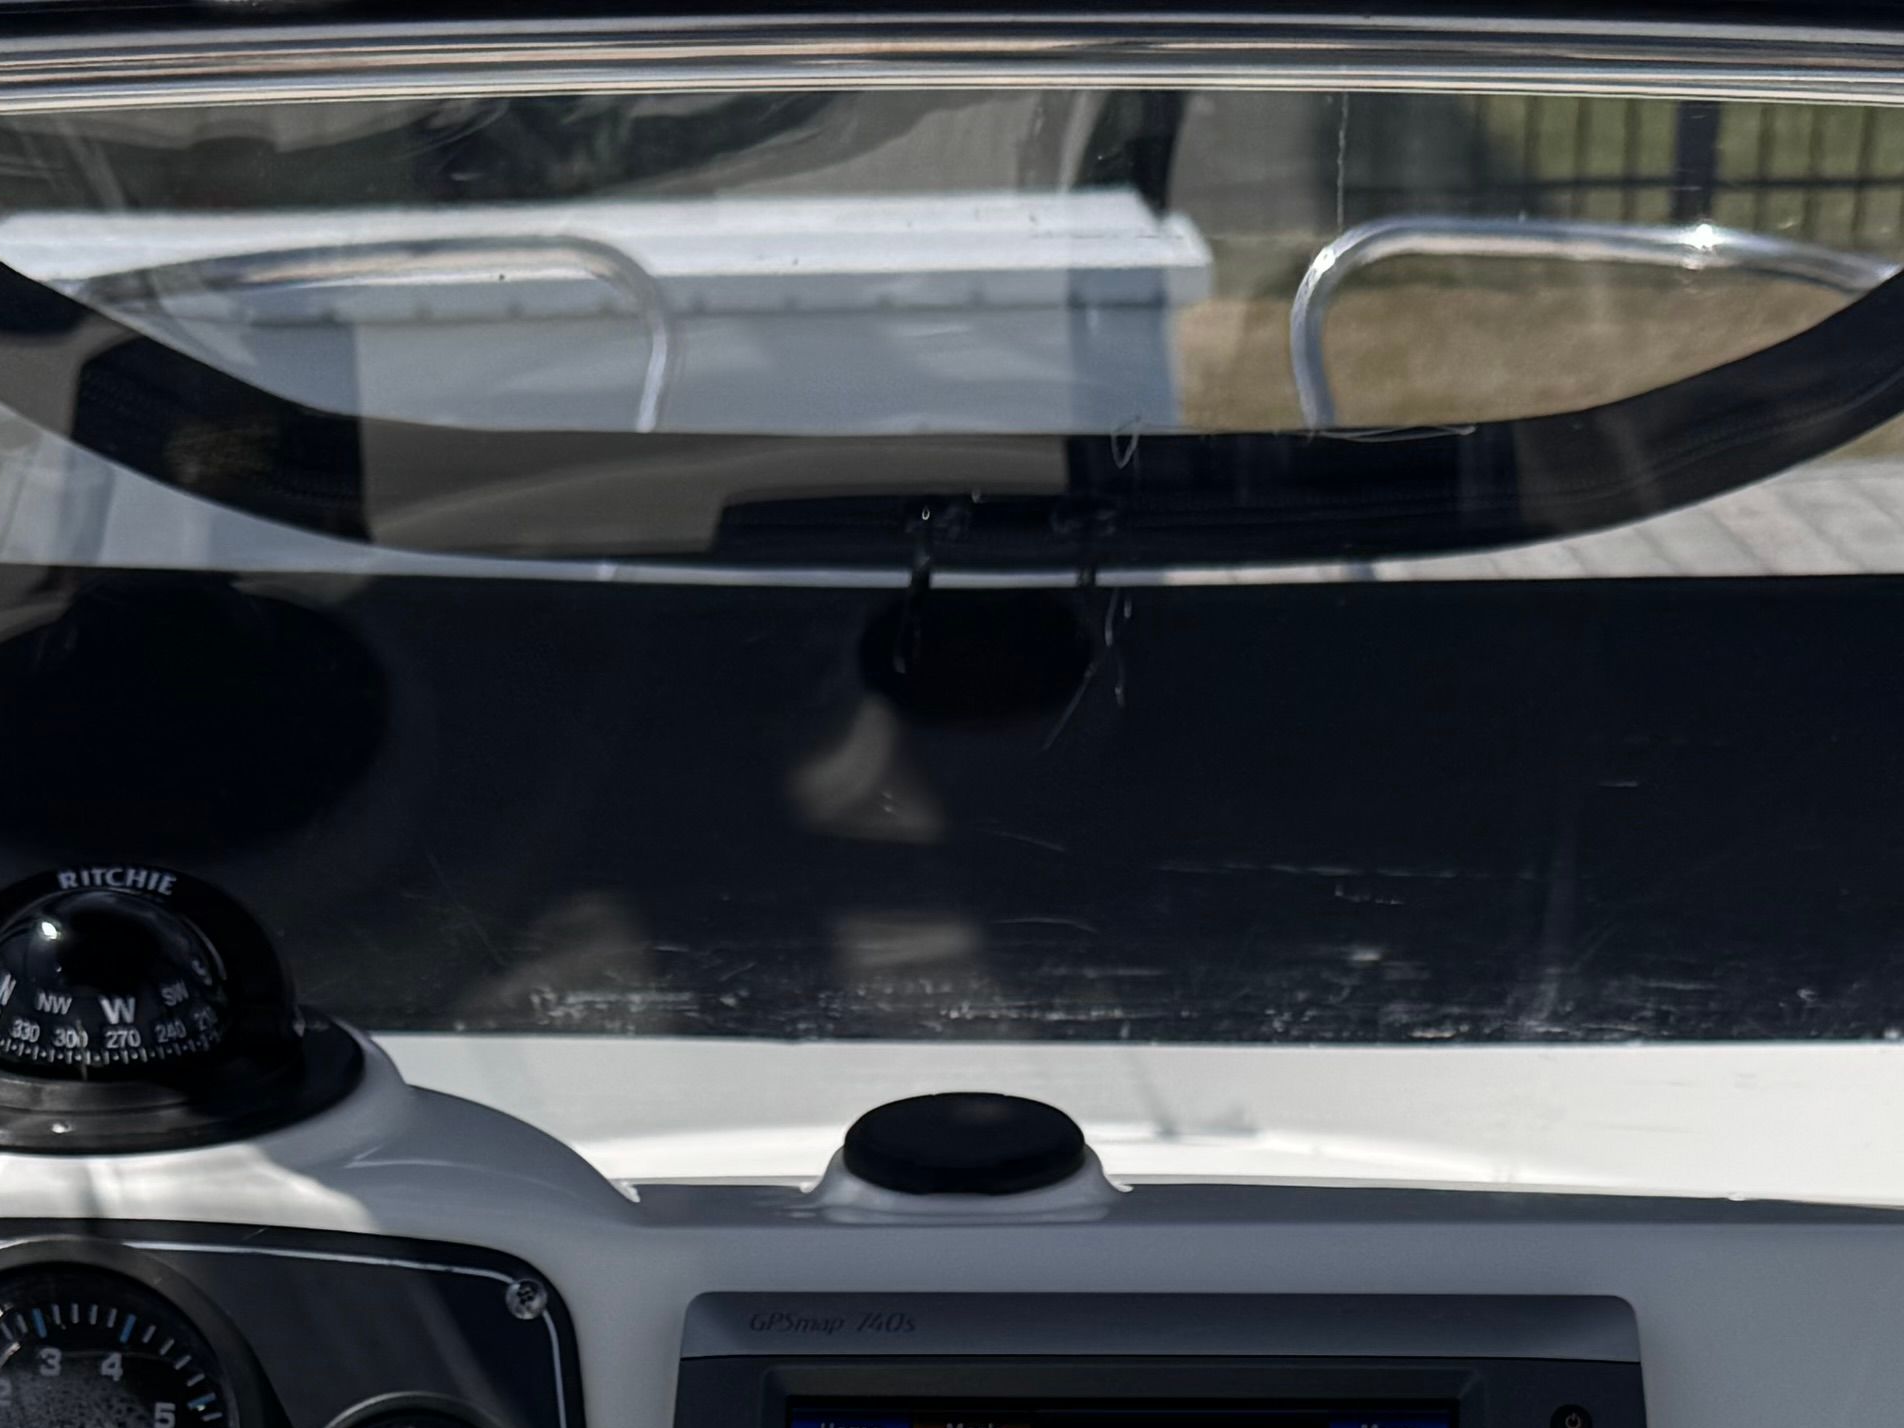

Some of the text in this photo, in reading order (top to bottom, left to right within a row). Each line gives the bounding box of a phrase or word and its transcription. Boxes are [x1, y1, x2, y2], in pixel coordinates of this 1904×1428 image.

[57, 867, 177, 896] RITCHIE
[36, 992, 73, 1016] NW
[99, 996, 137, 1025] W
[10, 1018, 41, 1044] 330
[104, 1028, 142, 1049] 270
[748, 1311, 845, 1335] GPSmap
[40, 1347, 63, 1377] 3
[101, 1351, 124, 1382] 4
